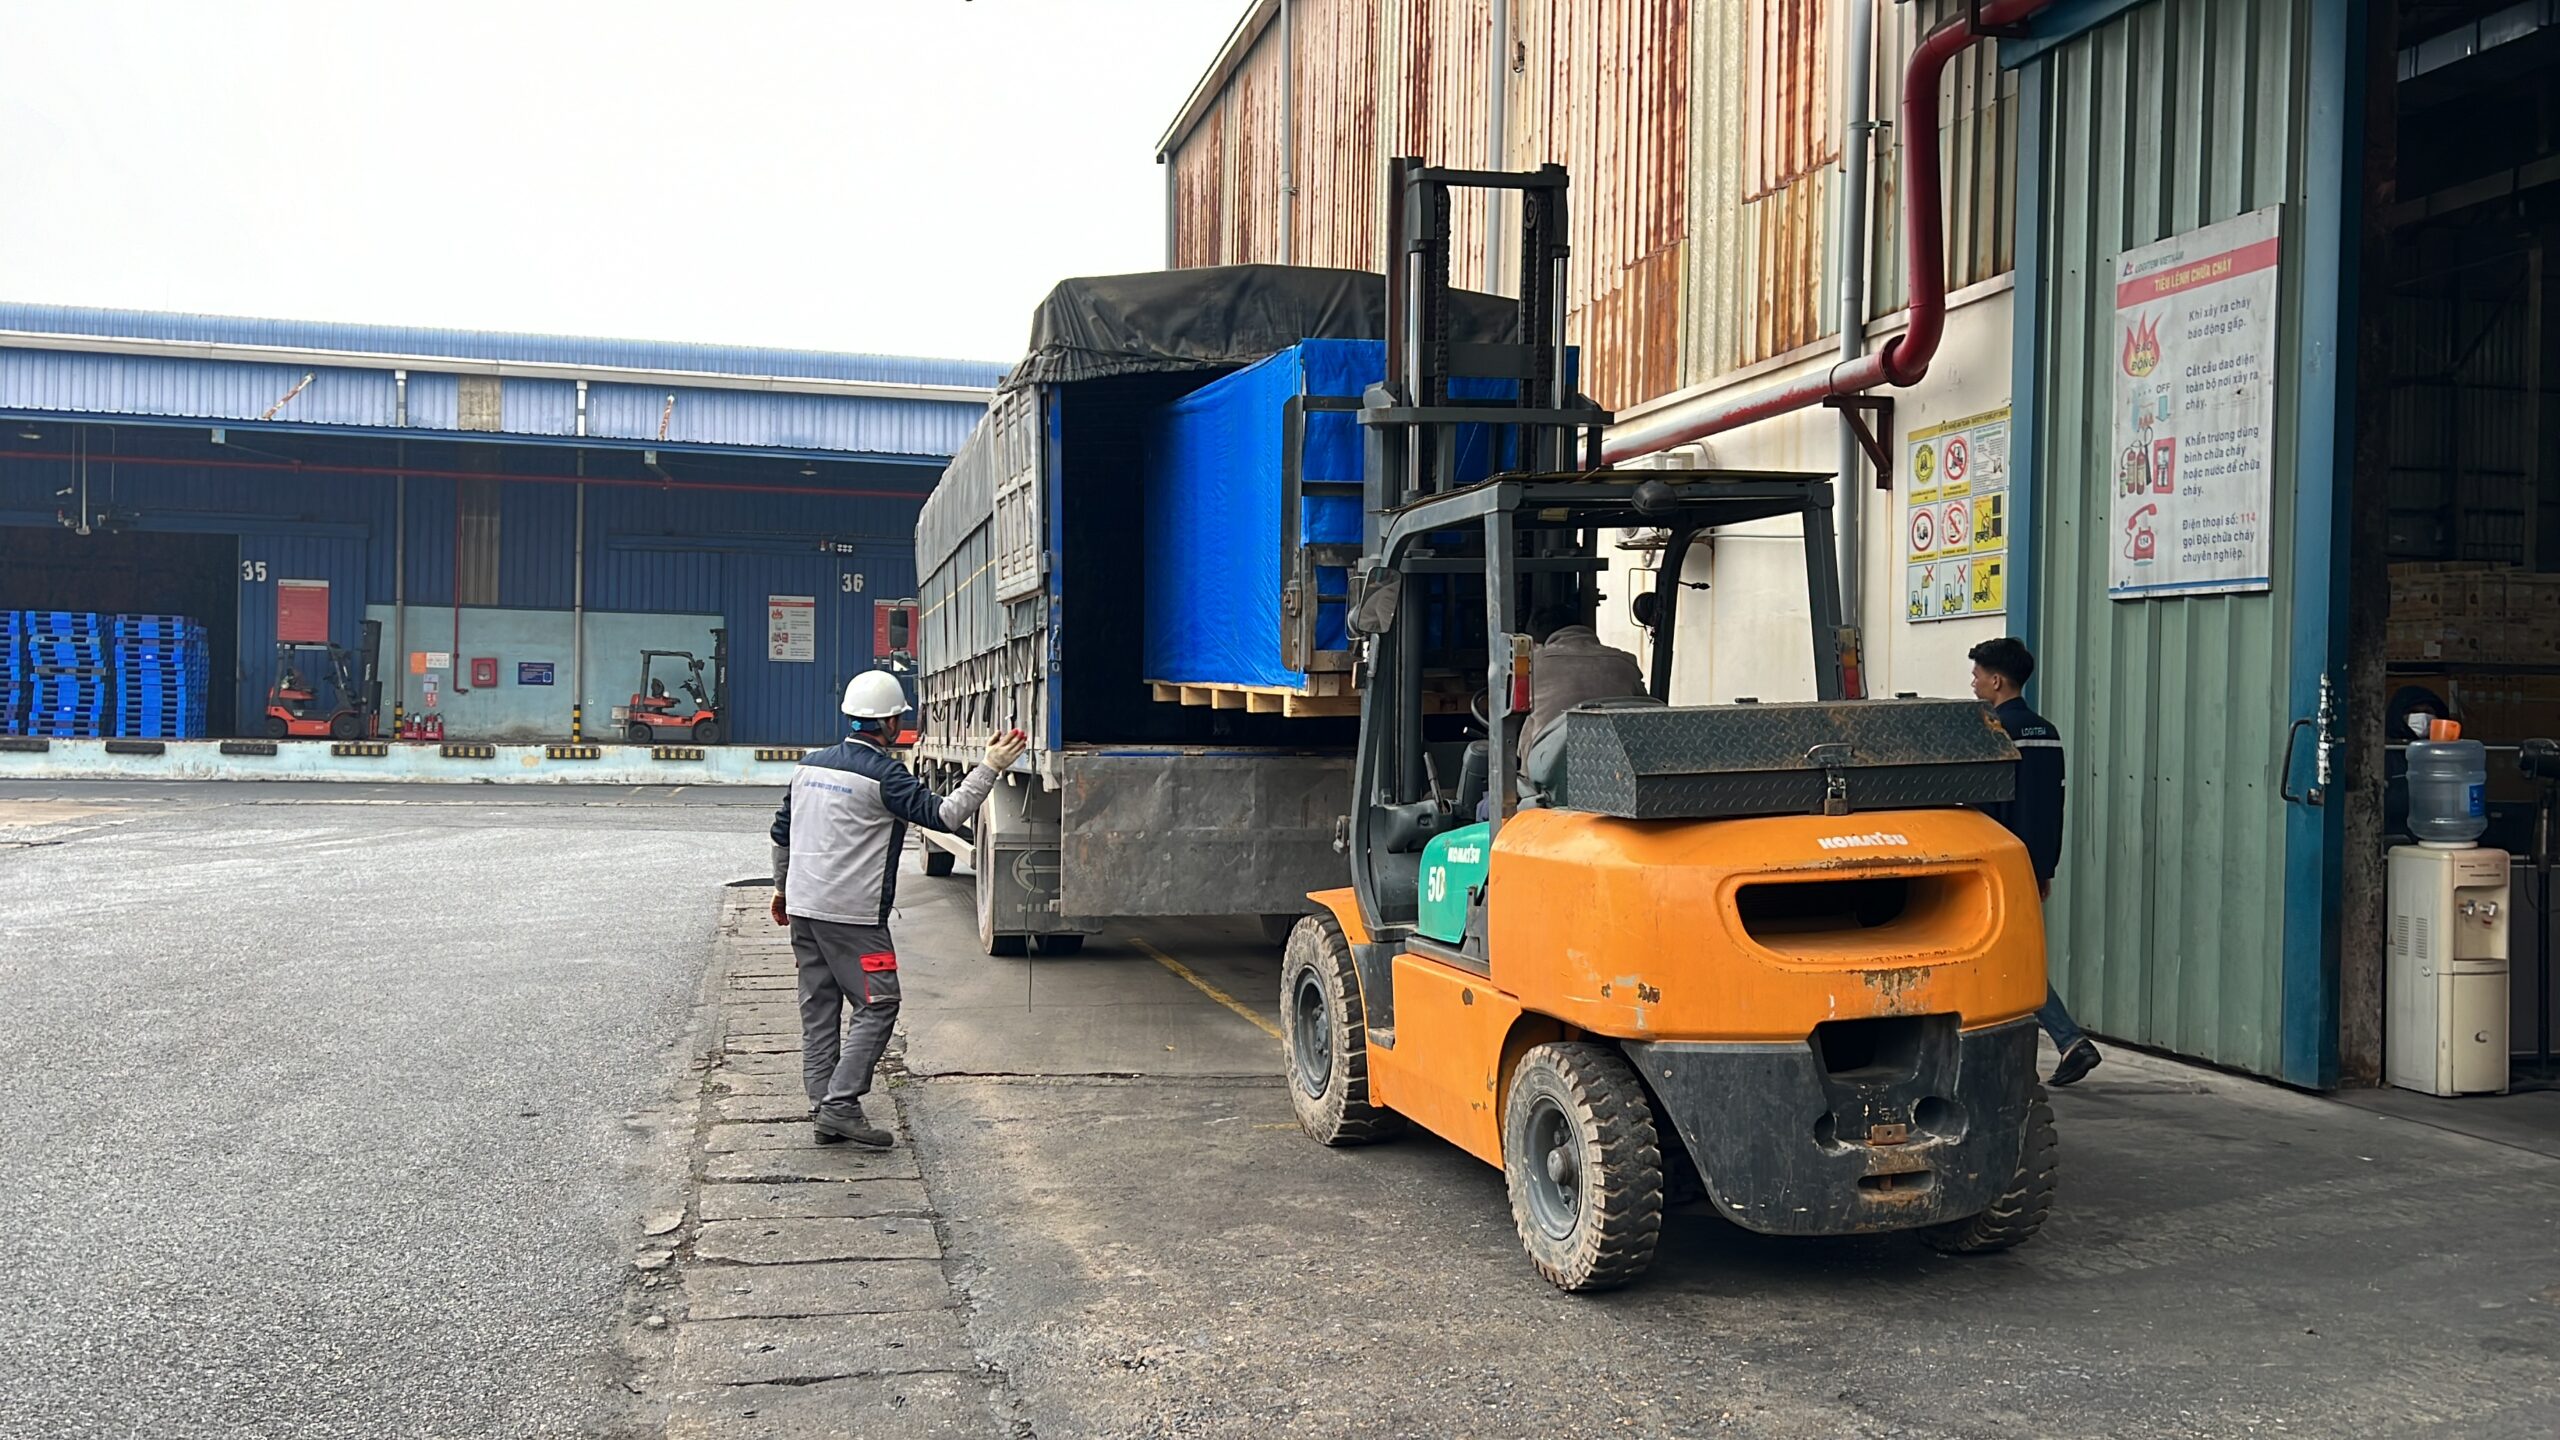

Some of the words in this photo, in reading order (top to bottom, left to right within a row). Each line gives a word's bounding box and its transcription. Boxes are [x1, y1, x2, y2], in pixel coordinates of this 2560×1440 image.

[2188, 308, 2202, 321] Khi
[2220, 303, 2229, 313] ra
[2230, 296, 2251, 310] cháy
[2204, 322, 2225, 336] động
[2219, 359, 2234, 370] dao
[2249, 371, 2258, 380] ra
[2156, 382, 2171, 394] OFF
[2225, 443, 2246, 457] cháy
[2182, 518, 2201, 531] Điện
[2202, 515, 2224, 528] thoại
[2241, 512, 2256, 524] 114
[2183, 536, 2195, 549] gọi
[2196, 533, 2210, 546] Đội
[2233, 529, 2255, 542] cháy
[2182, 550, 2212, 564] chuyên
[241, 560, 267, 582] 35
[842, 573, 864, 592] 36
[1817, 831, 1909, 850] KOMATSU
[1447, 843, 1481, 864] KOMATSU
[1427, 866, 1446, 902] 50
